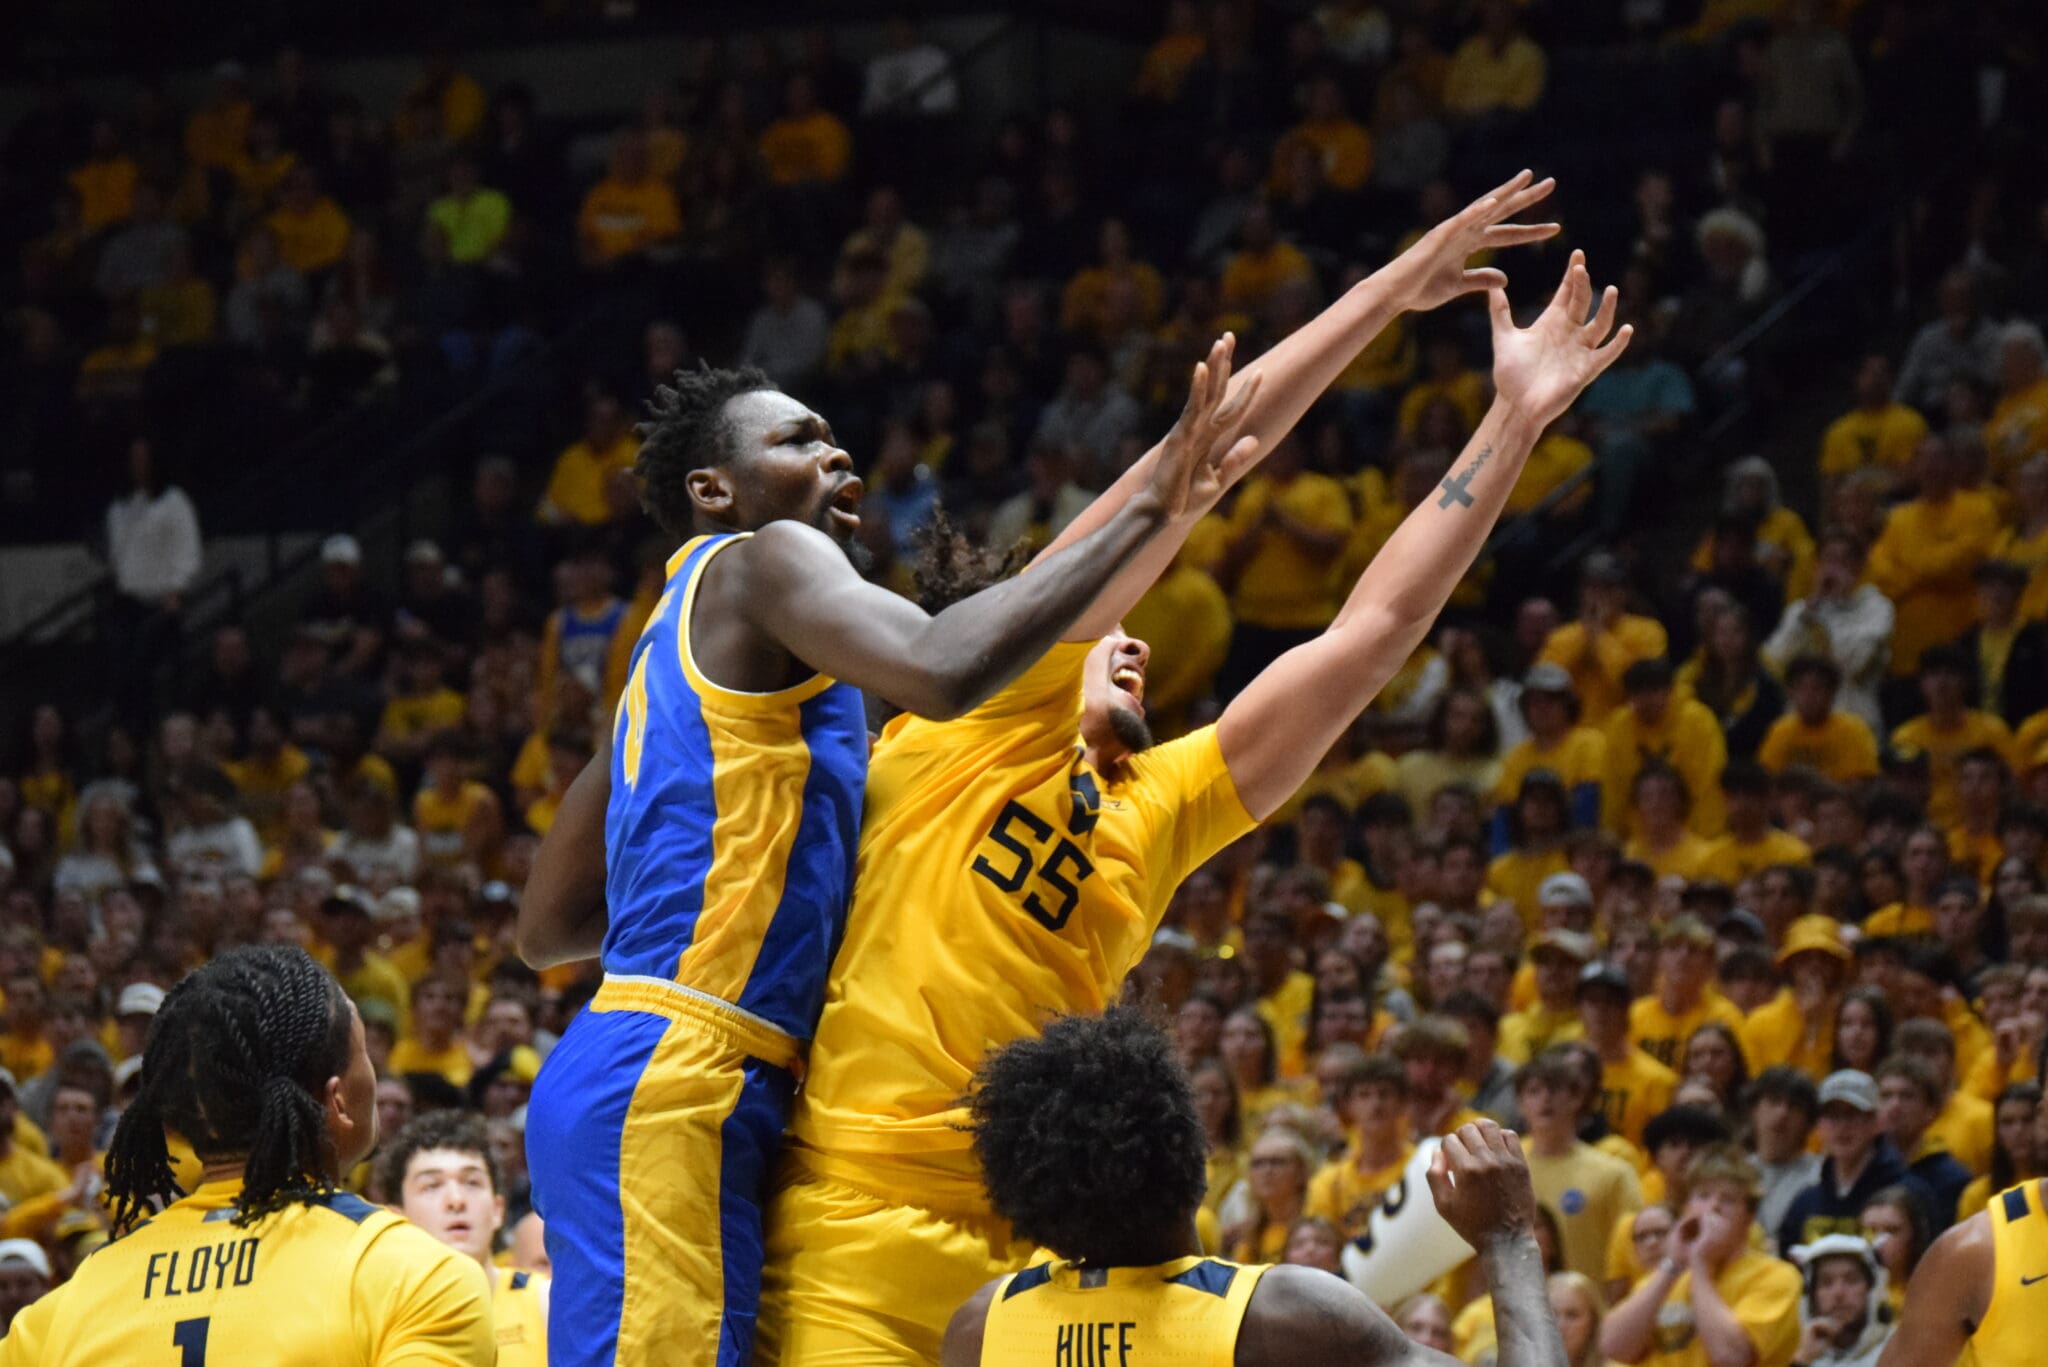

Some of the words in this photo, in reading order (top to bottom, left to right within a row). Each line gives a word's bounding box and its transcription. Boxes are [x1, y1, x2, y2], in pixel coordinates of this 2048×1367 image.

[970, 799, 1095, 932] 55
[143, 1238, 260, 1300] FLOYD
[1056, 1322, 1136, 1367] HUFF
